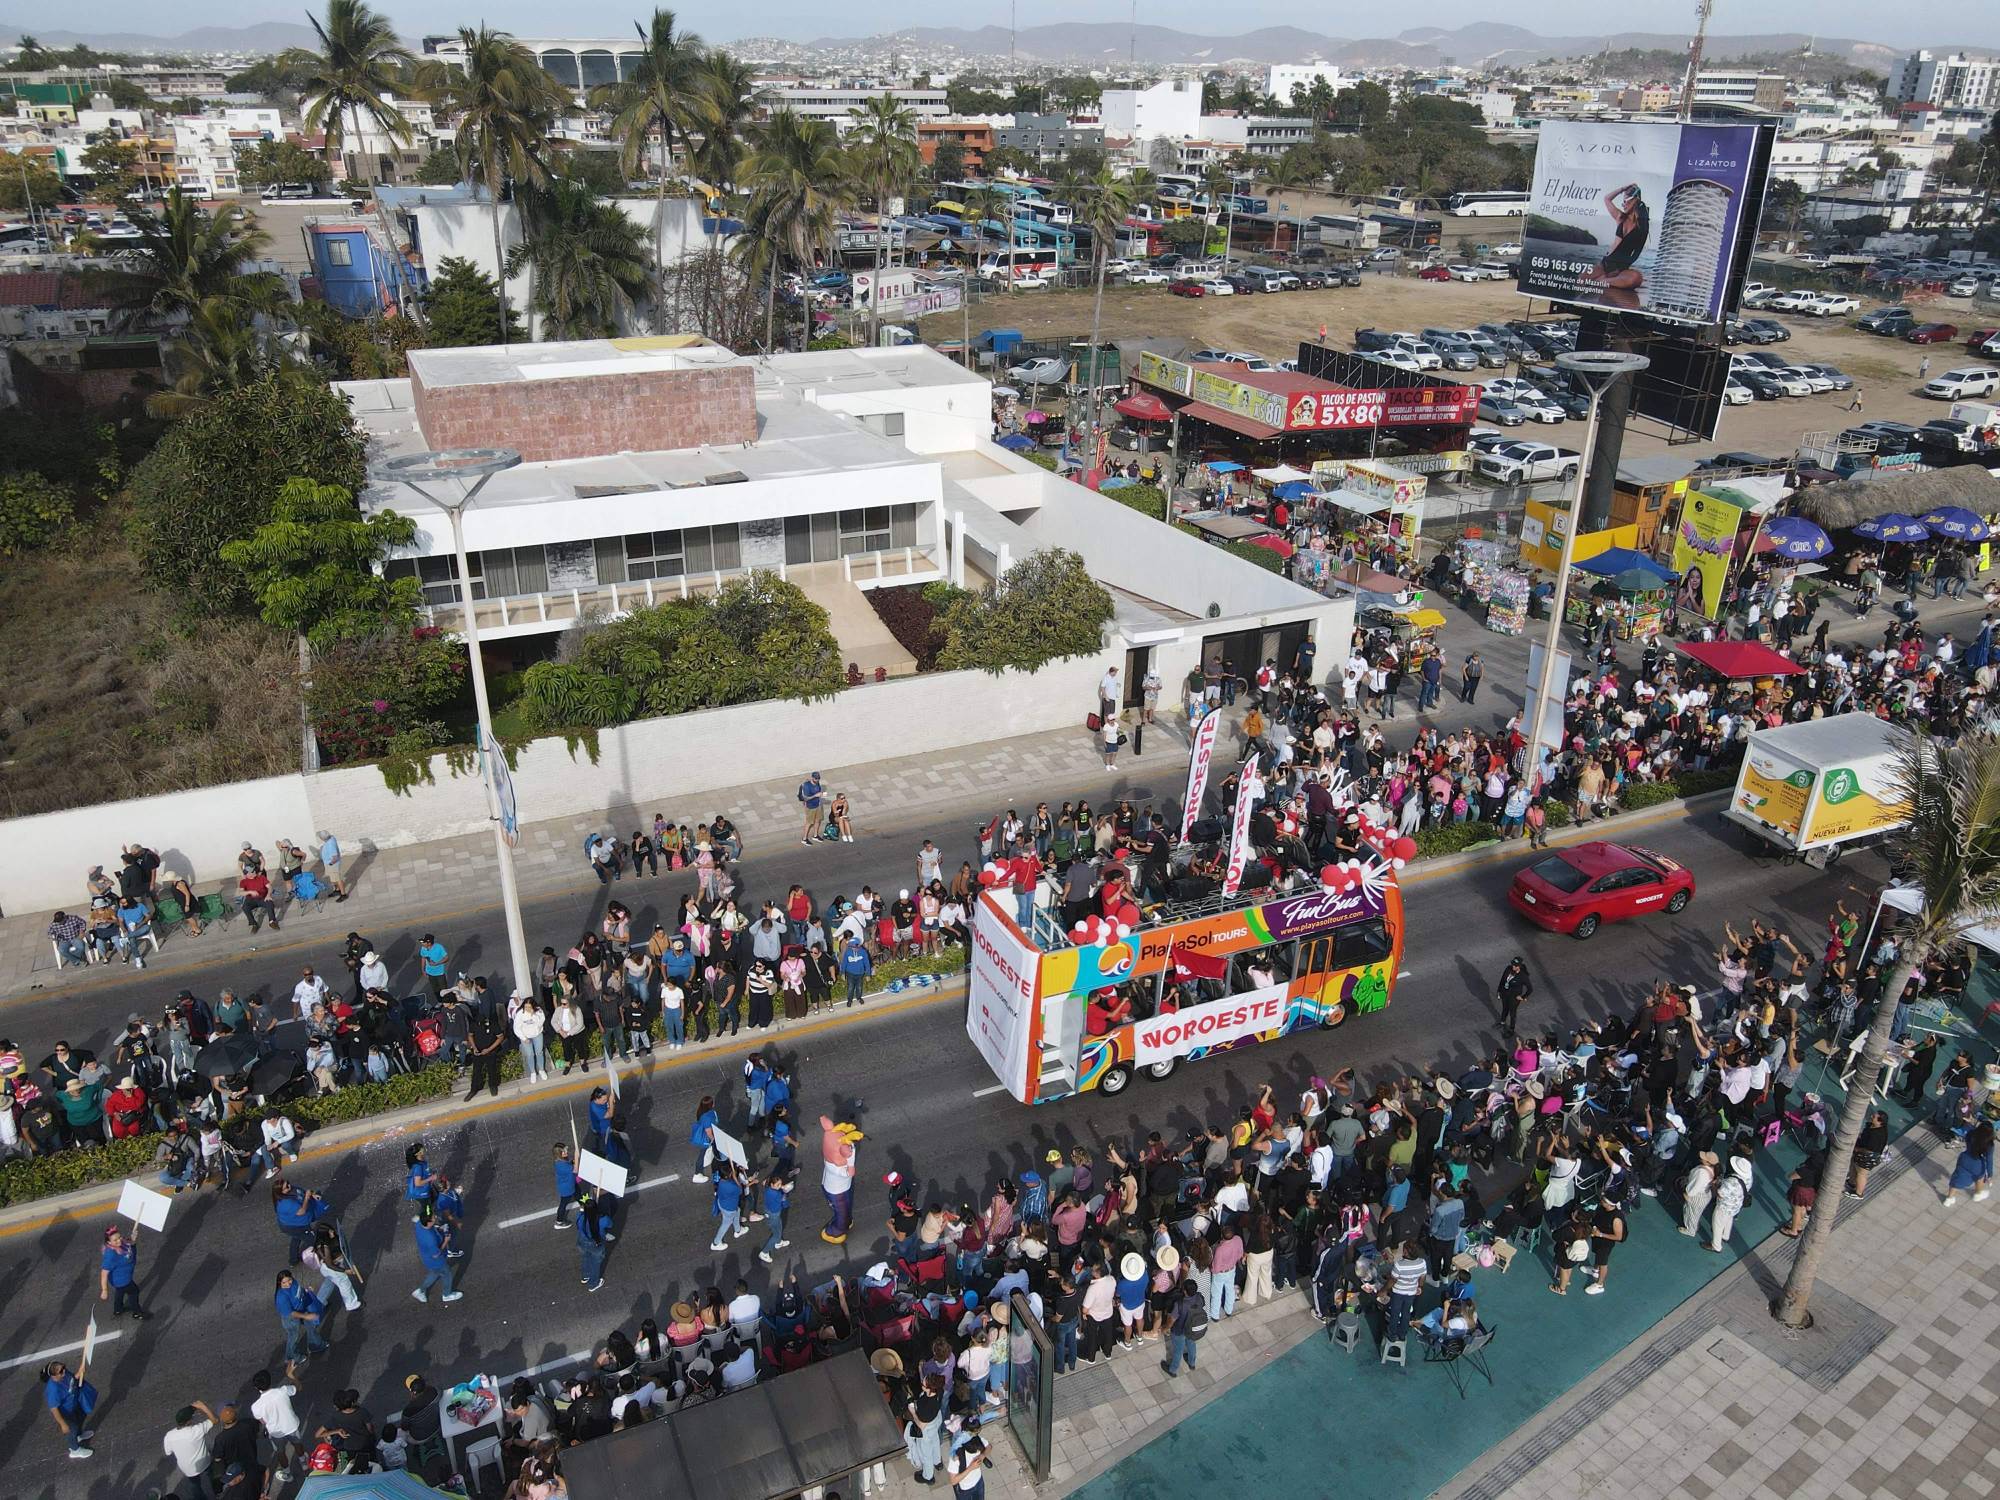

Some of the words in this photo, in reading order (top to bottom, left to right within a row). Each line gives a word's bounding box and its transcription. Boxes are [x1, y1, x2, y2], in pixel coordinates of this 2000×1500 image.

[1576, 144, 1637, 154] AZORA
[1688, 159, 1736, 168] LIZANTOS
[1544, 178, 1560, 197] El
[1558, 180, 1602, 201] placer
[1540, 202, 1550, 212] de
[1551, 205, 1598, 217] pertenecer
[1531, 256, 1549, 269] 669
[1552, 259, 1567, 271] 165
[1569, 262, 1594, 274] 4975
[1530, 270, 1546, 279] Frente
[1321, 394, 1347, 406] TACOS
[1348, 394, 1357, 404] DE
[1358, 392, 1386, 404] PASTOR
[1813, 829, 1836, 839] NUEVA
[1280, 910, 1364, 936] www.playasoltours.com
[972, 925, 1031, 998] NOROESTE
[1142, 998, 1280, 1048] NOROESTE
